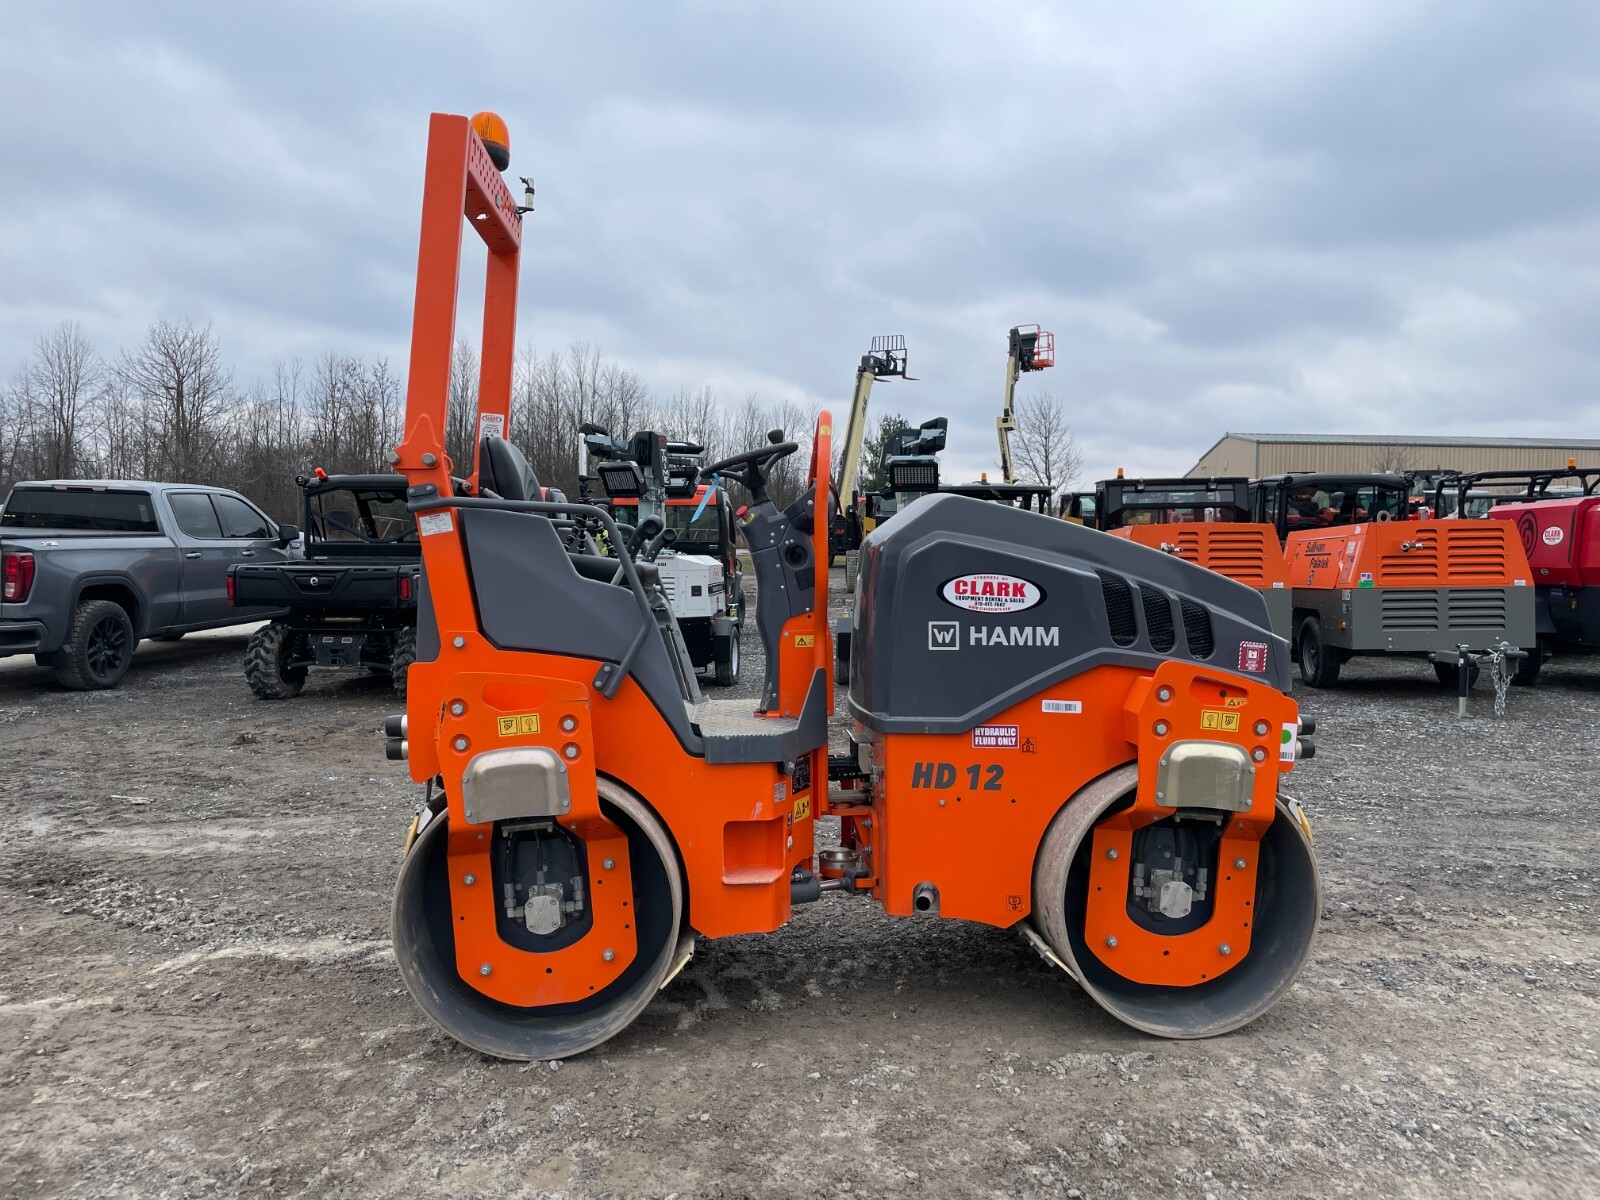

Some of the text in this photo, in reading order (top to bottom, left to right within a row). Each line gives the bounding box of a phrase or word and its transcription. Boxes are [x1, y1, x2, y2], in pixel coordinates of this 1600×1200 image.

[660, 448, 670, 484] TRIME
[954, 579, 1027, 598] CLARK
[969, 626, 1059, 647] HAMM
[974, 727, 1017, 736] HYDRAULIC
[974, 736, 1016, 745] FLUID ONLY
[911, 762, 1005, 791] HD 12
